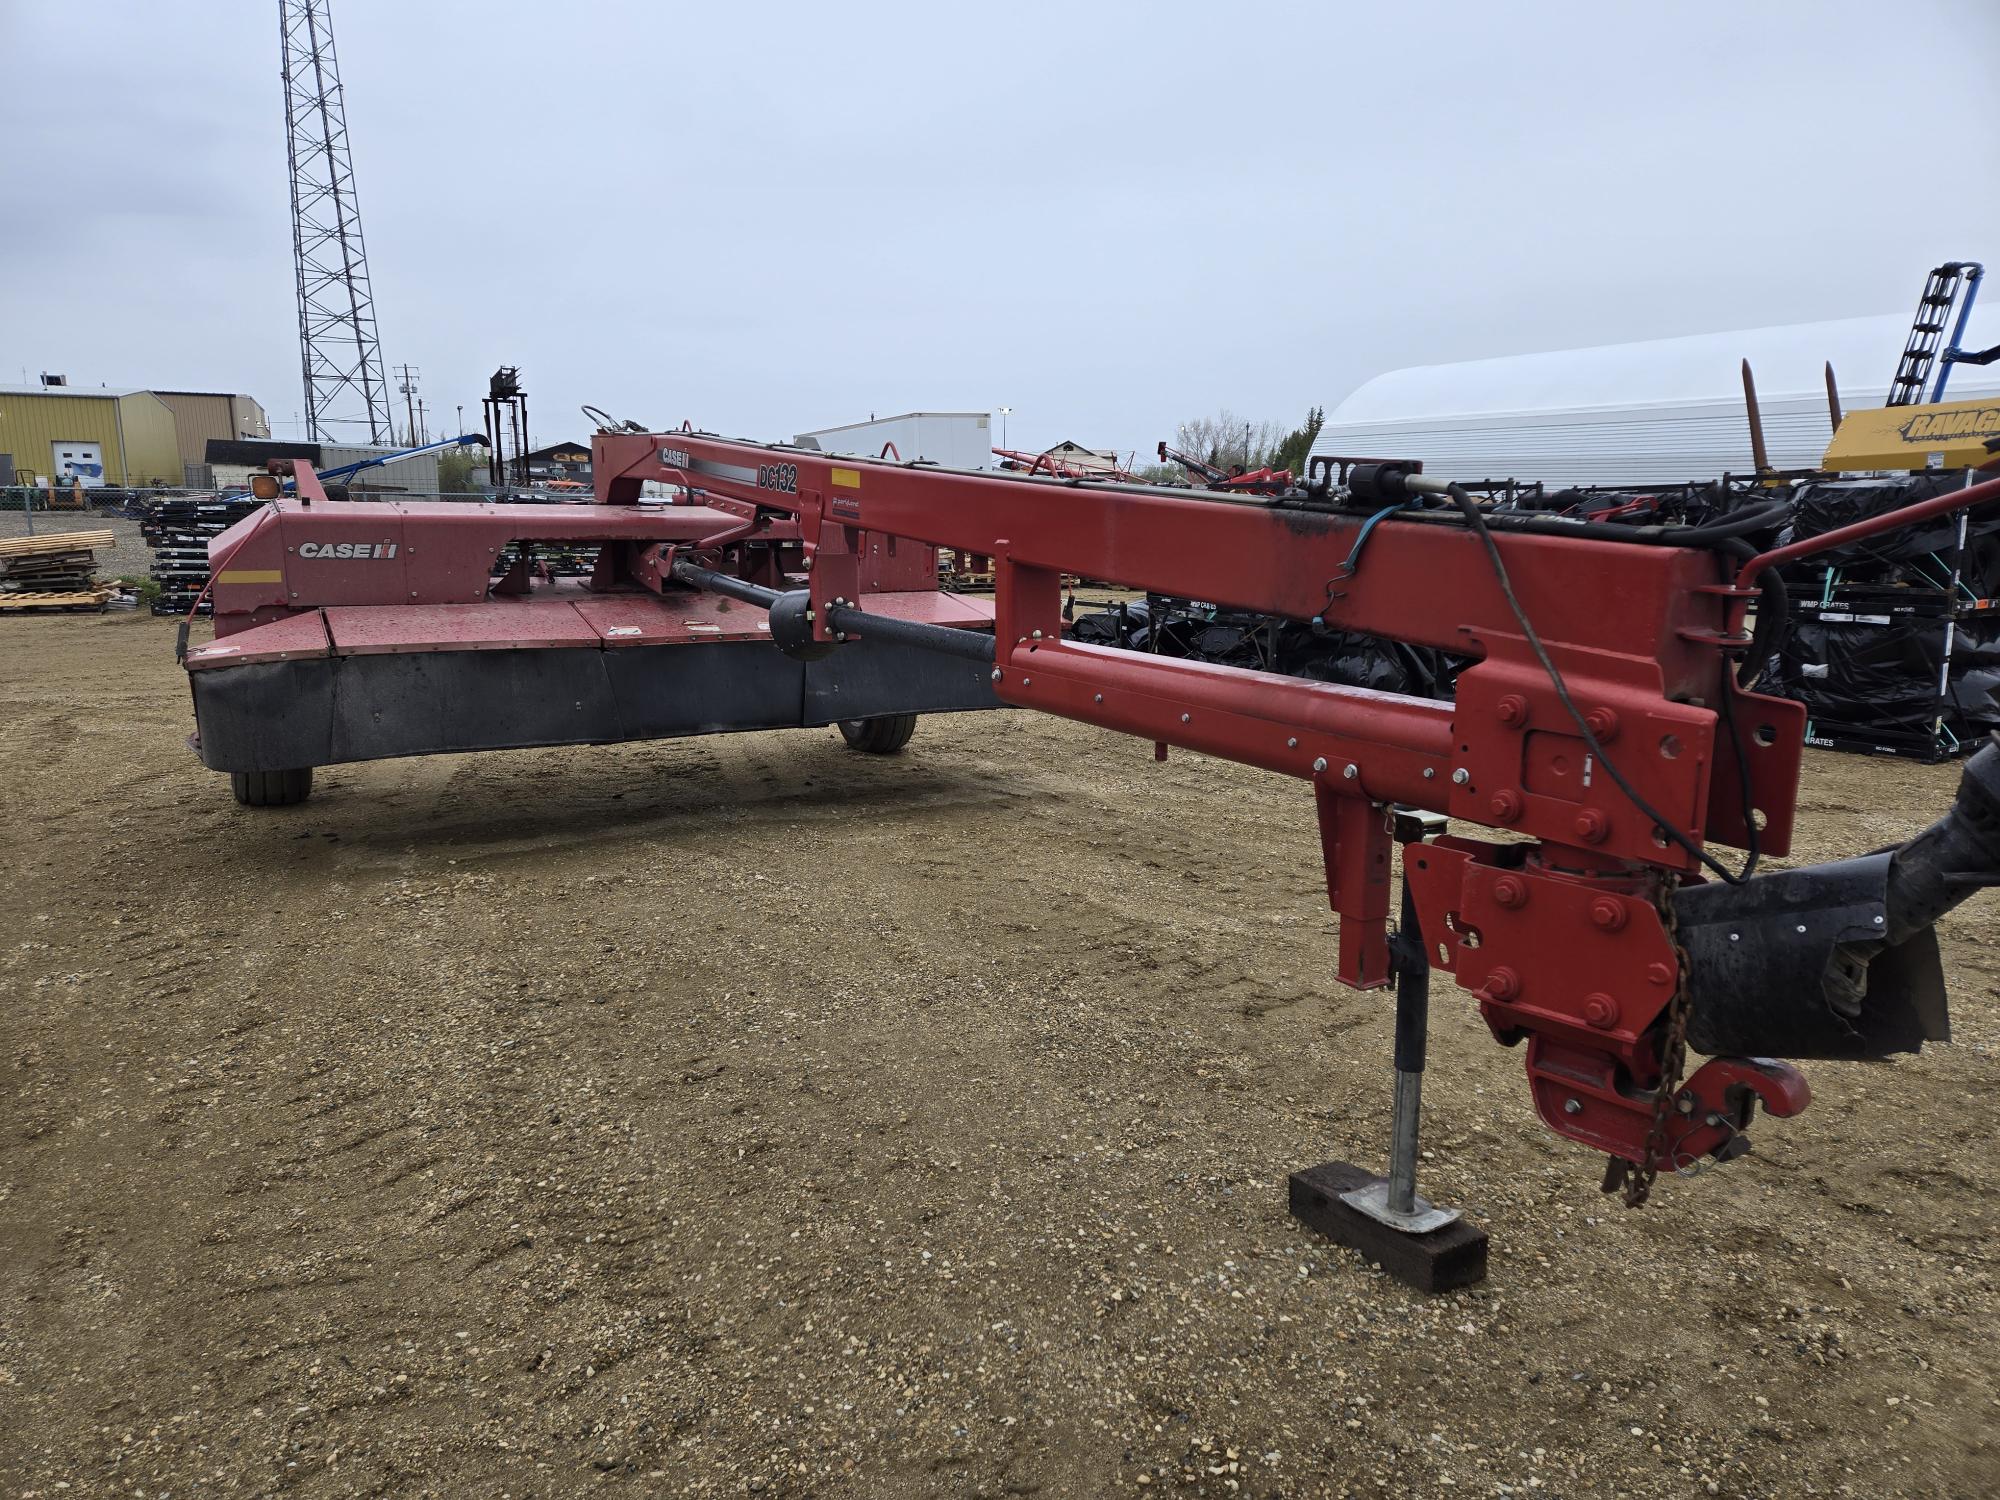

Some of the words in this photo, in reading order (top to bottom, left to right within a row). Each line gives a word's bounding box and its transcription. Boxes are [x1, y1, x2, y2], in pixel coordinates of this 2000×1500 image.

[663, 447, 682, 466] CASE
[759, 463, 797, 494] DC132
[299, 542, 372, 559] CASE
[1800, 600, 1818, 608] WMP
[1806, 737, 1834, 747] RATES
